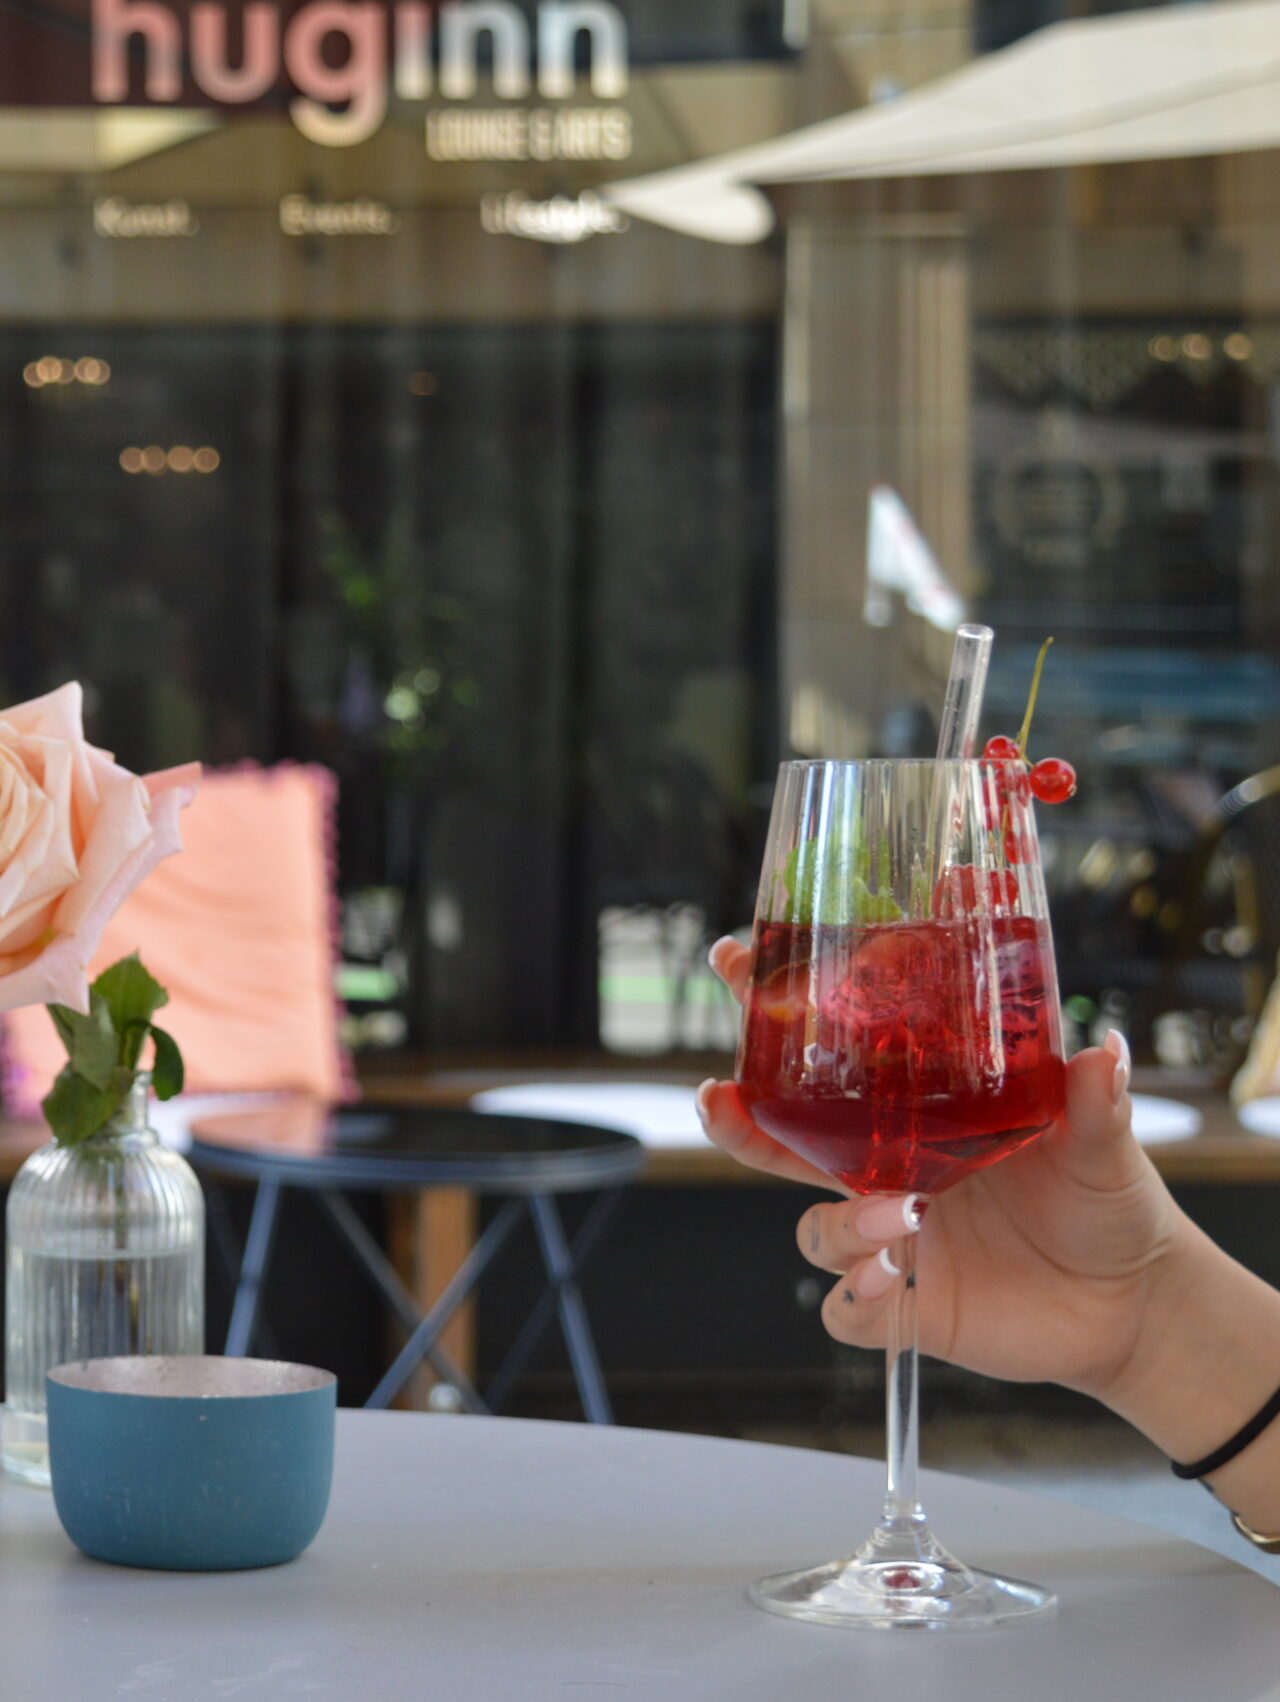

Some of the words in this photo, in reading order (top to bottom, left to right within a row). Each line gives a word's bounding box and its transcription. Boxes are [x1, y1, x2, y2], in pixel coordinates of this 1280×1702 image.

[91, 0, 628, 148] huginn
[426, 108, 528, 161] LOUNGE
[553, 108, 631, 161] ARTS
